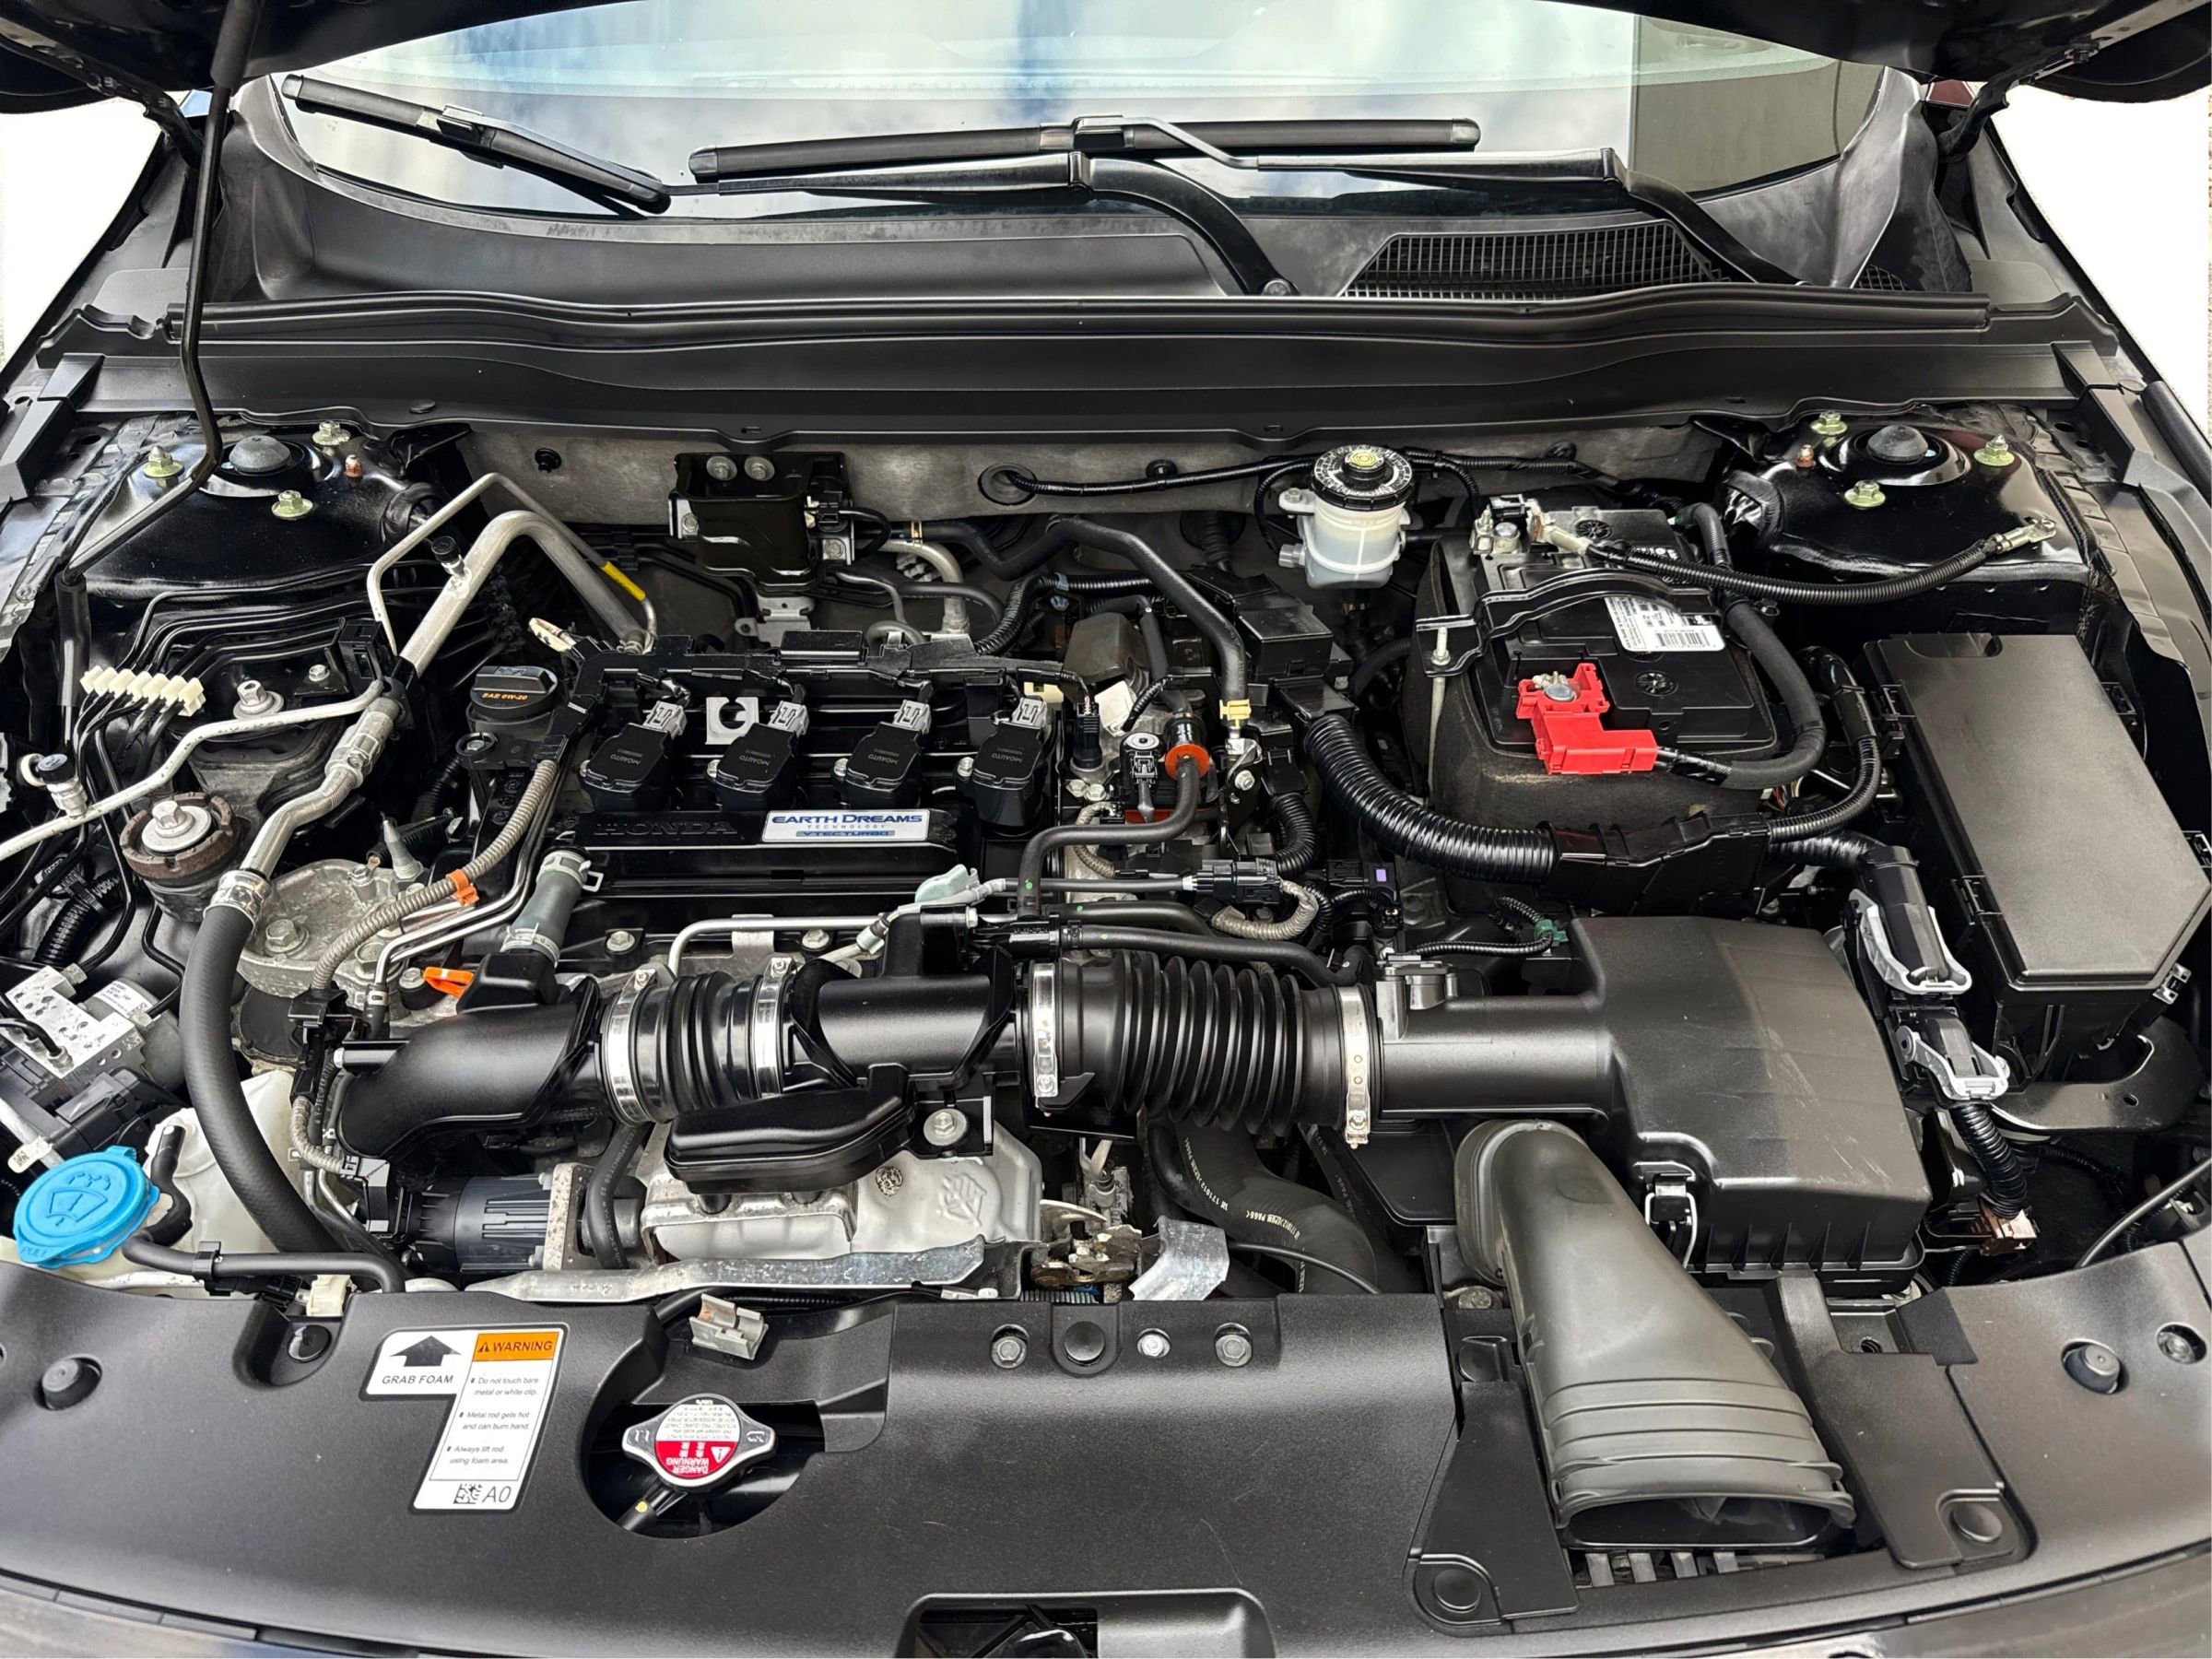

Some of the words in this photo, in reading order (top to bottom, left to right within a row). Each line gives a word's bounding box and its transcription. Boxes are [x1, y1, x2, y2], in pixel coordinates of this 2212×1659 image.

[771, 815, 837, 824] EARTH
[593, 820, 738, 836] HONDA
[493, 1341, 553, 1352] WARNING
[382, 1375, 416, 1384] GRAB
[418, 1374, 453, 1383] FOAM
[500, 1411, 516, 1419] gets
[665, 1457, 710, 1466] WARNUNG
[673, 1465, 709, 1476] DANGER
[481, 1486, 512, 1503] A0
